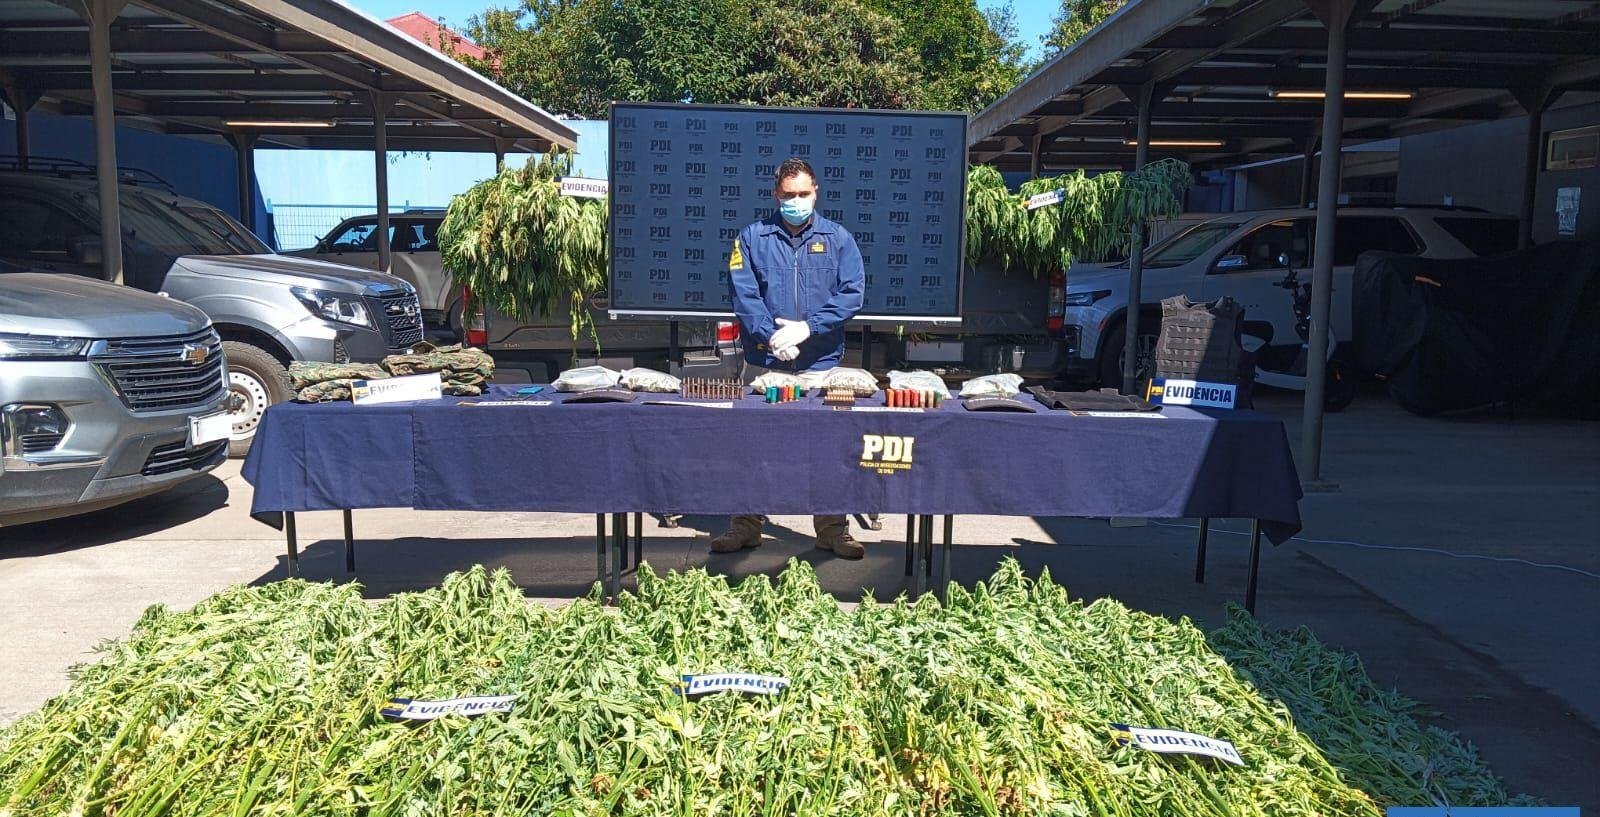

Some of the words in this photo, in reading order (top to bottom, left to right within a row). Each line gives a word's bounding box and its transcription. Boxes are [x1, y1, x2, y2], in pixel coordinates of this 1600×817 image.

[616, 117, 636, 128] PDI
[686, 119, 706, 130] PDI
[756, 121, 776, 132] PDI
[826, 123, 846, 134] PDI
[892, 125, 912, 136] PDI
[619, 141, 632, 149] PDI
[651, 140, 671, 151] PDI
[721, 142, 741, 153] PDI
[790, 144, 810, 155] PDI
[857, 146, 877, 157] PDI
[926, 148, 945, 158] PDI
[616, 161, 636, 172] PDI
[654, 164, 667, 172] PDI
[685, 163, 706, 174] PDI
[755, 165, 775, 175] PDI
[824, 167, 844, 178] PDI
[860, 170, 873, 178] PDI
[891, 168, 911, 179] PDI
[928, 172, 941, 180] PDI
[562, 183, 607, 194] EVIDENCIA
[651, 184, 671, 194] PDI
[720, 186, 740, 196] PDI
[856, 189, 876, 200] PDI
[924, 191, 944, 202] PDI
[615, 204, 635, 215] PDI
[685, 206, 705, 217] PDI
[889, 212, 910, 222] PDI
[651, 227, 670, 237] PDI
[855, 232, 875, 242] PDI
[923, 234, 942, 244] PDI
[615, 247, 635, 258] PDI
[685, 249, 704, 259] PDI
[888, 254, 908, 264] PDI
[650, 269, 670, 280] PDI
[921, 276, 941, 286] PDI
[685, 291, 704, 302] PDI
[887, 296, 906, 306] PDI
[1165, 385, 1232, 402] EVIDENCIA
[862, 434, 915, 462] PDI
